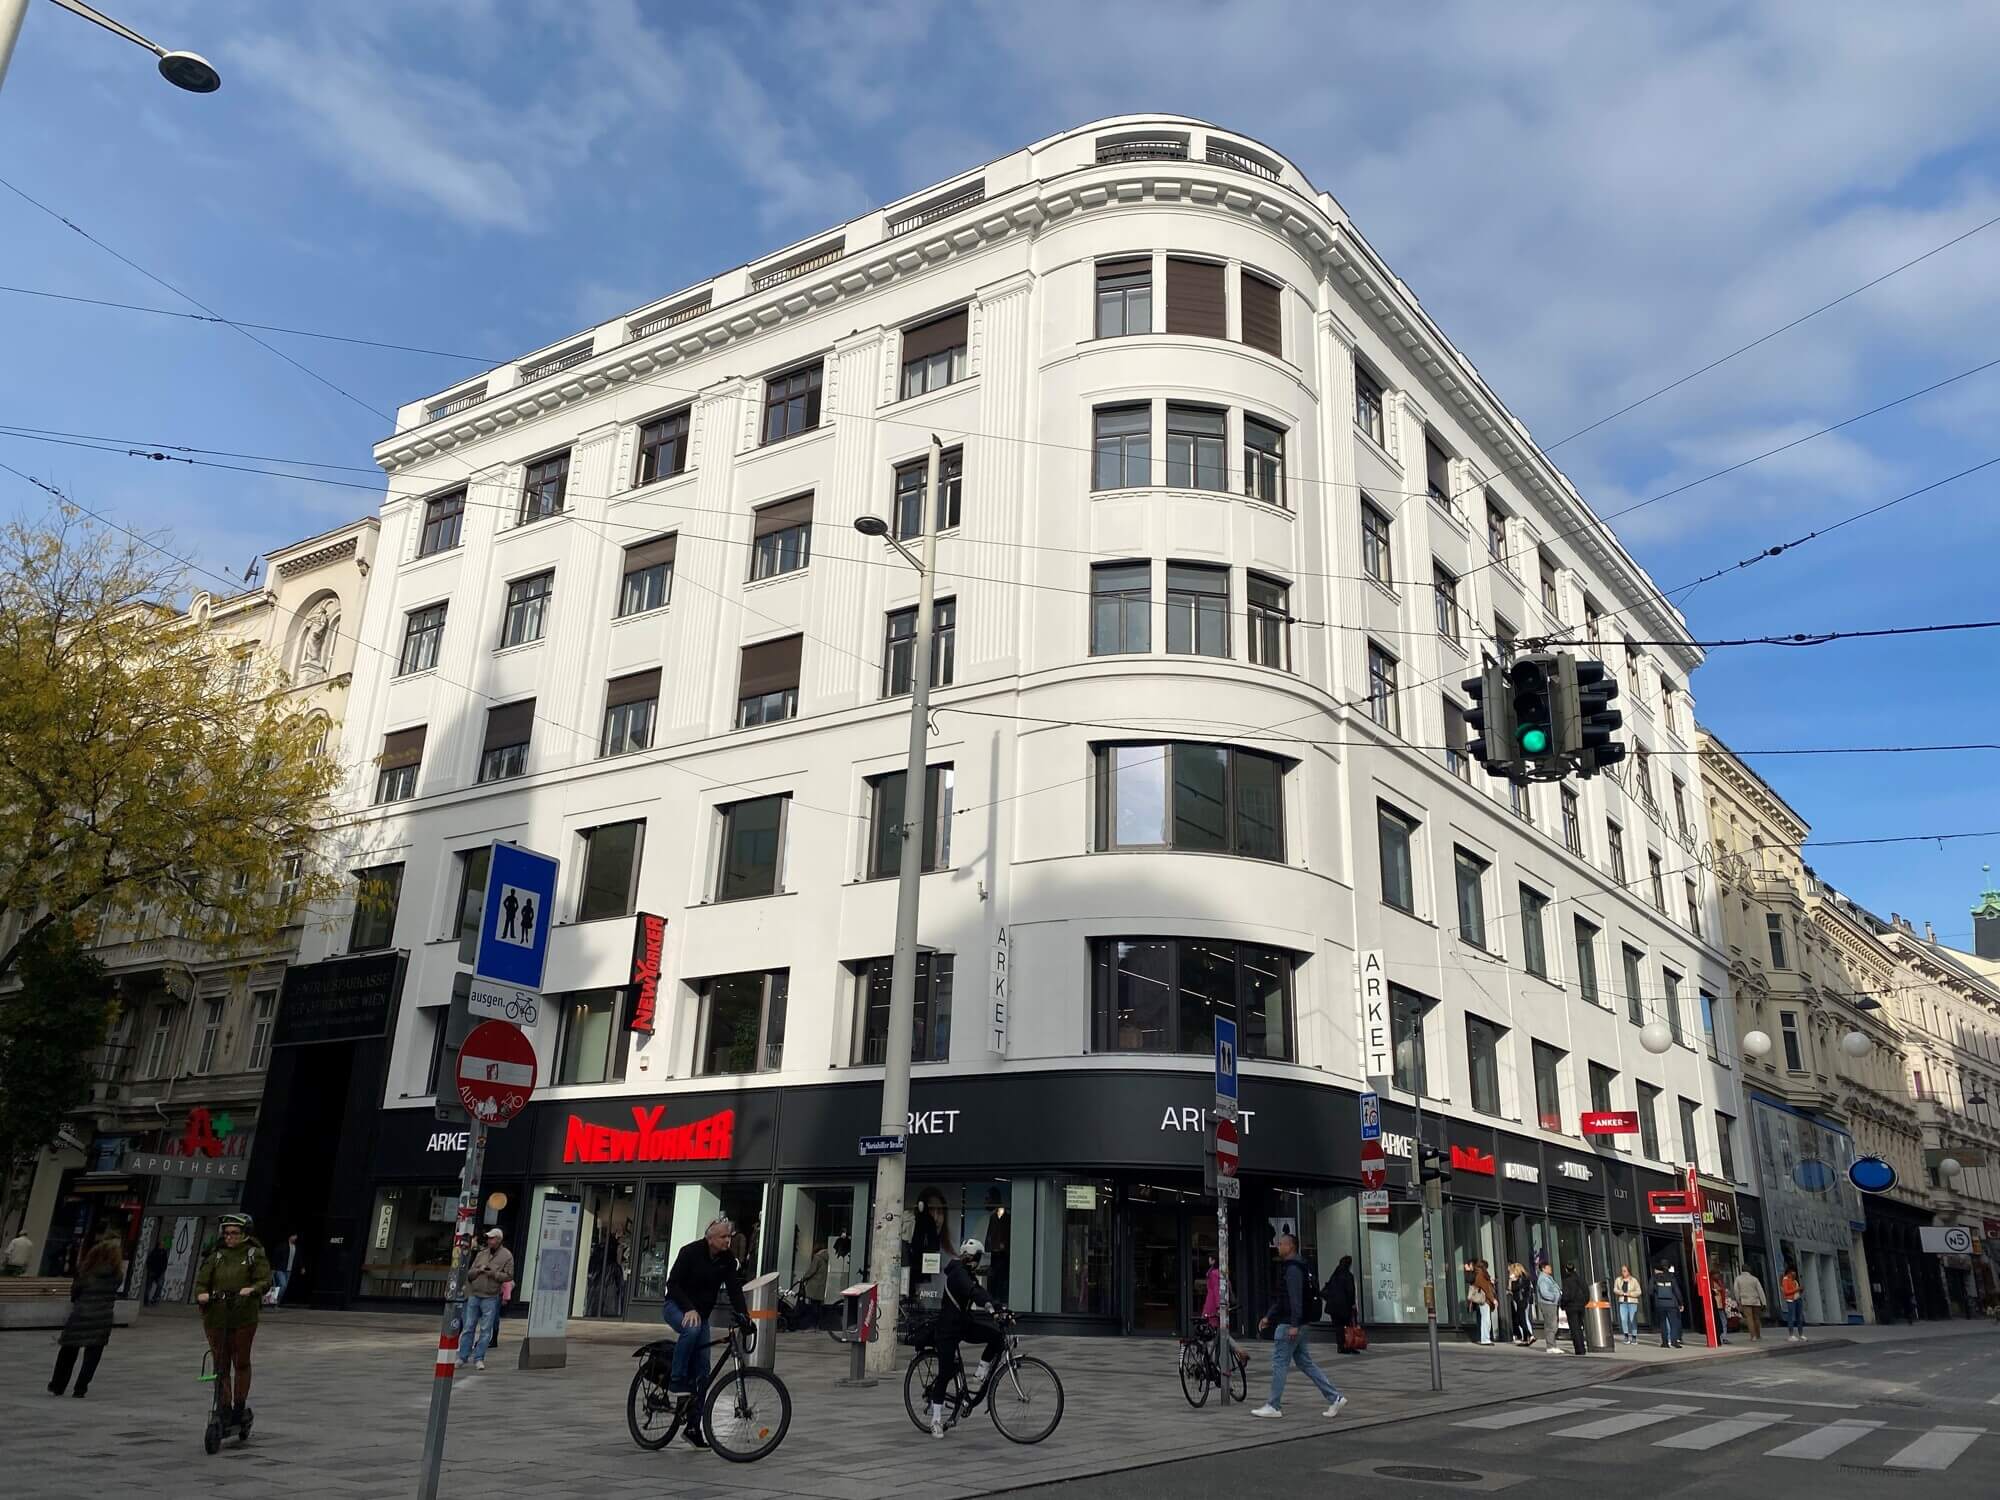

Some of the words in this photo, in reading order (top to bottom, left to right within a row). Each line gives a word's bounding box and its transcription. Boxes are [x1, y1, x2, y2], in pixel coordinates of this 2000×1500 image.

[471, 991, 506, 1008] ausgen.
[994, 927, 1007, 1049] ARKET
[1365, 953, 1387, 1073] ARKET
[907, 1110, 961, 1134] RKET
[1160, 1106, 1256, 1135] ART
[426, 1132, 471, 1152] ARKE
[1381, 1131, 1413, 1158] ARKE
[132, 1157, 240, 1176] APOTHEKE
[1706, 1199, 1732, 1221] UMEN
[1949, 1233, 1965, 1246] N5
